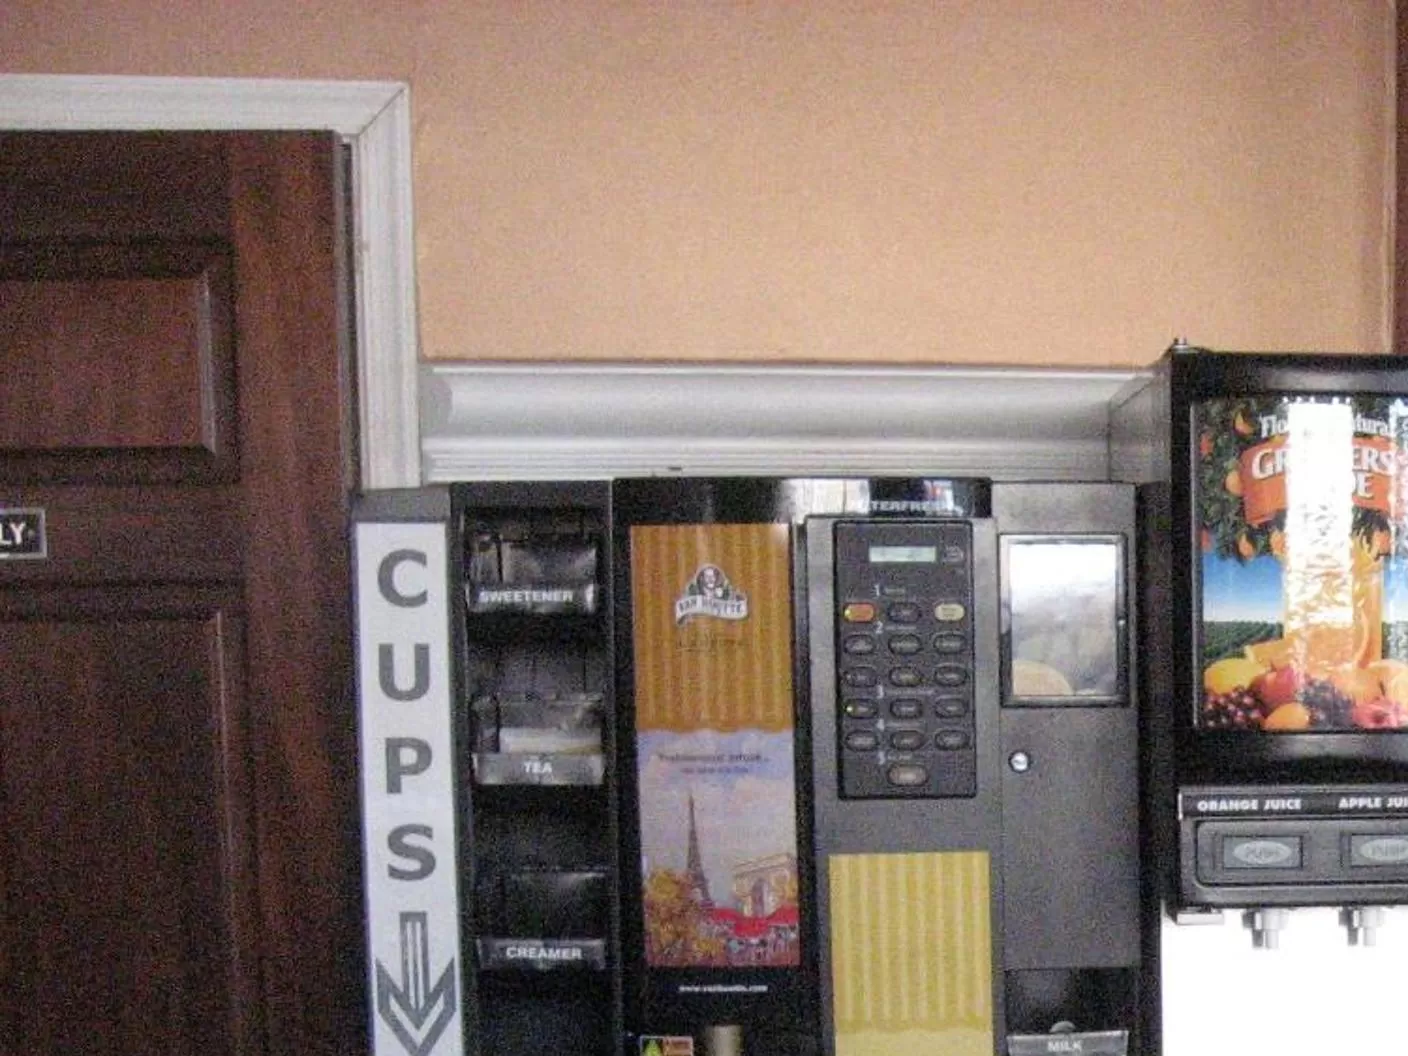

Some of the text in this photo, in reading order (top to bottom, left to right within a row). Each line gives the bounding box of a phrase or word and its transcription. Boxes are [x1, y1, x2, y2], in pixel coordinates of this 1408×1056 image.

[479, 590, 574, 603] SWEETENER
[377, 548, 437, 881] CUPS
[523, 760, 553, 774] TEA
[1197, 798, 1302, 812] ORANGE JUICE
[1338, 796, 1382, 809] APPLE
[505, 947, 583, 960] CREAMER
[1048, 1040, 1082, 1052] MILK
